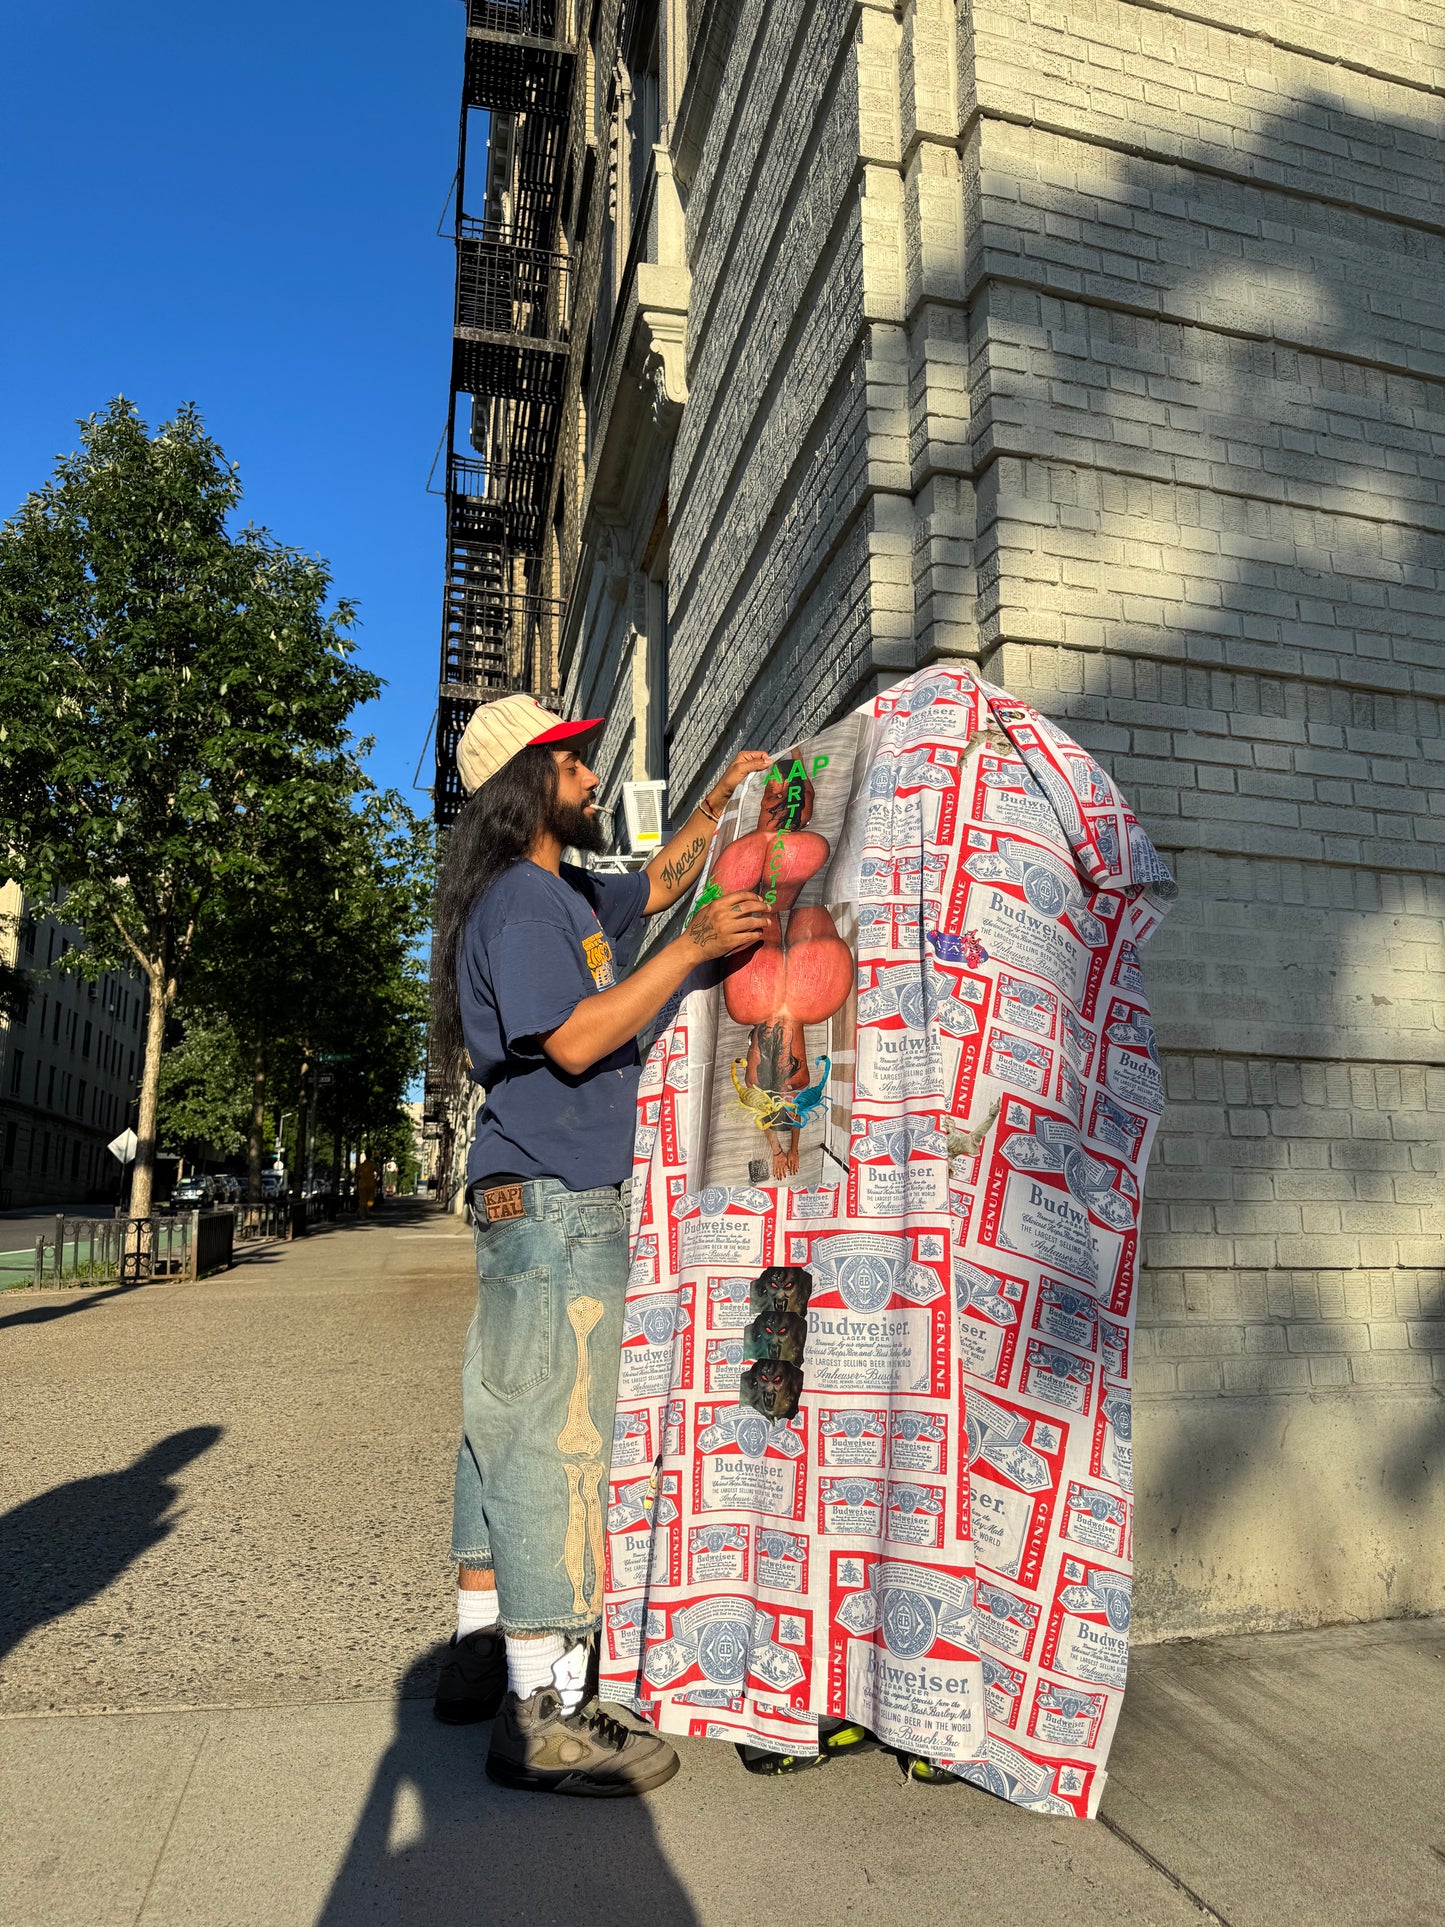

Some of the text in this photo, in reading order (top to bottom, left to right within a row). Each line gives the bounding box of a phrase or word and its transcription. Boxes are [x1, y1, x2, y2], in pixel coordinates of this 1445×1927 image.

[941, 793, 954, 842] GENUINE
[975, 787, 983, 819] GENUINE
[949, 881, 966, 934] ENUINE
[989, 891, 1078, 962] Budweiser.
[994, 931, 1014, 946] LARGEST
[1016, 942, 1038, 955] SELLING
[1085, 957, 1102, 1016] GENUINE
[957, 1045, 975, 1114] GENUINE
[663, 1094, 675, 1163] GENUINE
[486, 1188, 522, 1206] KAPI
[868, 1167, 934, 1182] Budwser.
[984, 1167, 1004, 1241] GENUINE
[1021, 1224, 1081, 1255] THE LARGEST SELLING
[1115, 1239, 1134, 1311] GENUINE
[808, 1312, 910, 1336] Budweiser.
[805, 1357, 813, 1365] THE
[816, 1359, 841, 1367] LARGEST
[936, 1311, 946, 1393] GENUINE
[999, 1332, 1015, 1384] GENUINE
[715, 1457, 783, 1478] Budweiser.
[1092, 1420, 1104, 1474] GENUINE
[961, 1448, 969, 1535] GENUINE
[980, 1532, 1001, 1547] WORLD
[1024, 1502, 1048, 1584] GENUINE
[1044, 1610, 1060, 1666] GENUINE
[833, 1639, 843, 1714] ENUINE
[906, 1687, 930, 1697] BEER
[880, 1709, 901, 1722] SELLING
[905, 1716, 920, 1728] BEER
[924, 1720, 932, 1729] IN
[936, 1721, 948, 1731] THE
[951, 1724, 971, 1732] WORLD
